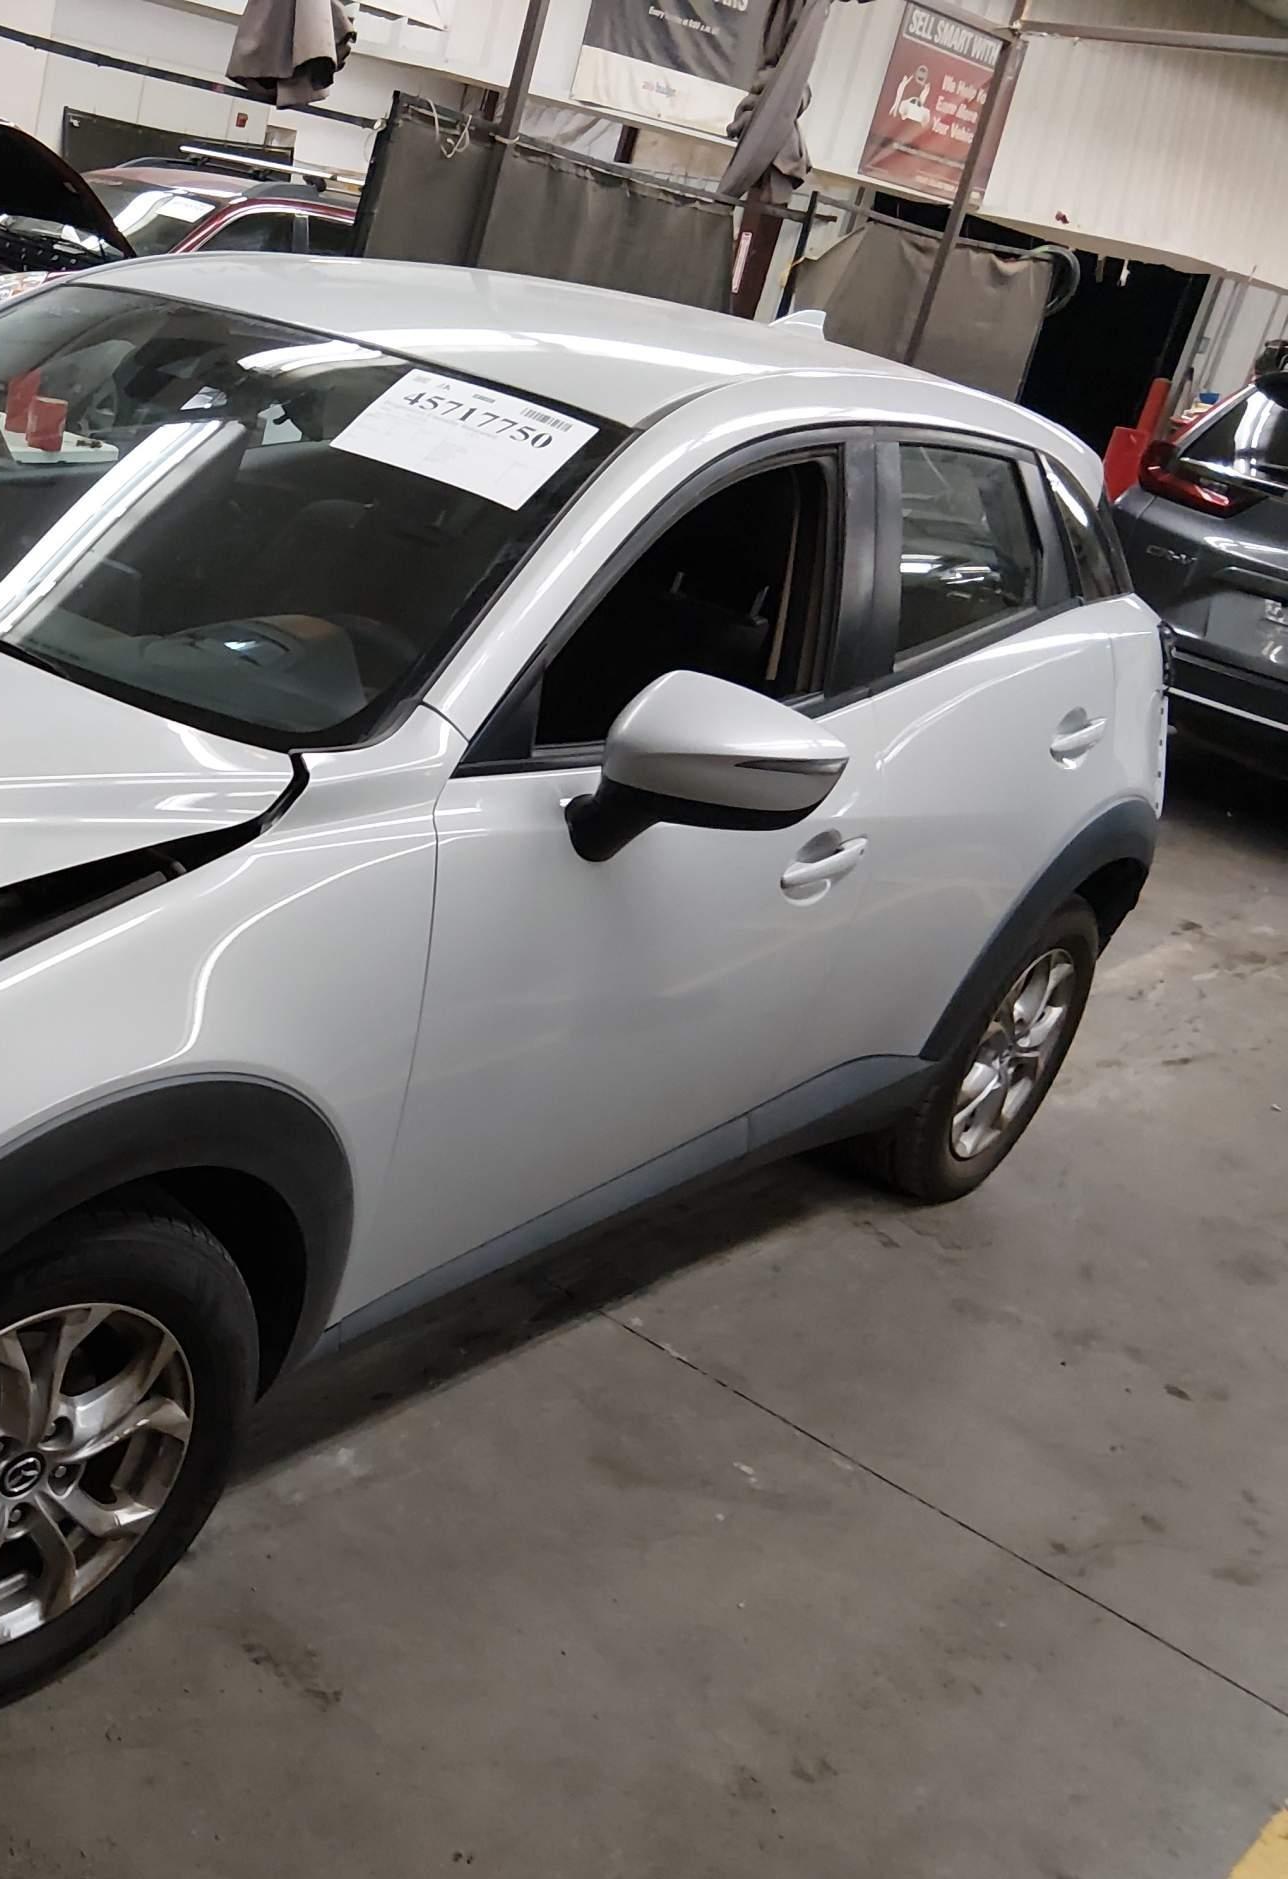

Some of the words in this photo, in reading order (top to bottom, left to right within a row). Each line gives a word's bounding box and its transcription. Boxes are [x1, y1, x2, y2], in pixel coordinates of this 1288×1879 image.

[909, 10, 935, 40] SELL
[934, 20, 974, 55] SMART
[971, 36, 1003, 65] WITH
[403, 391, 553, 449] 45717750
